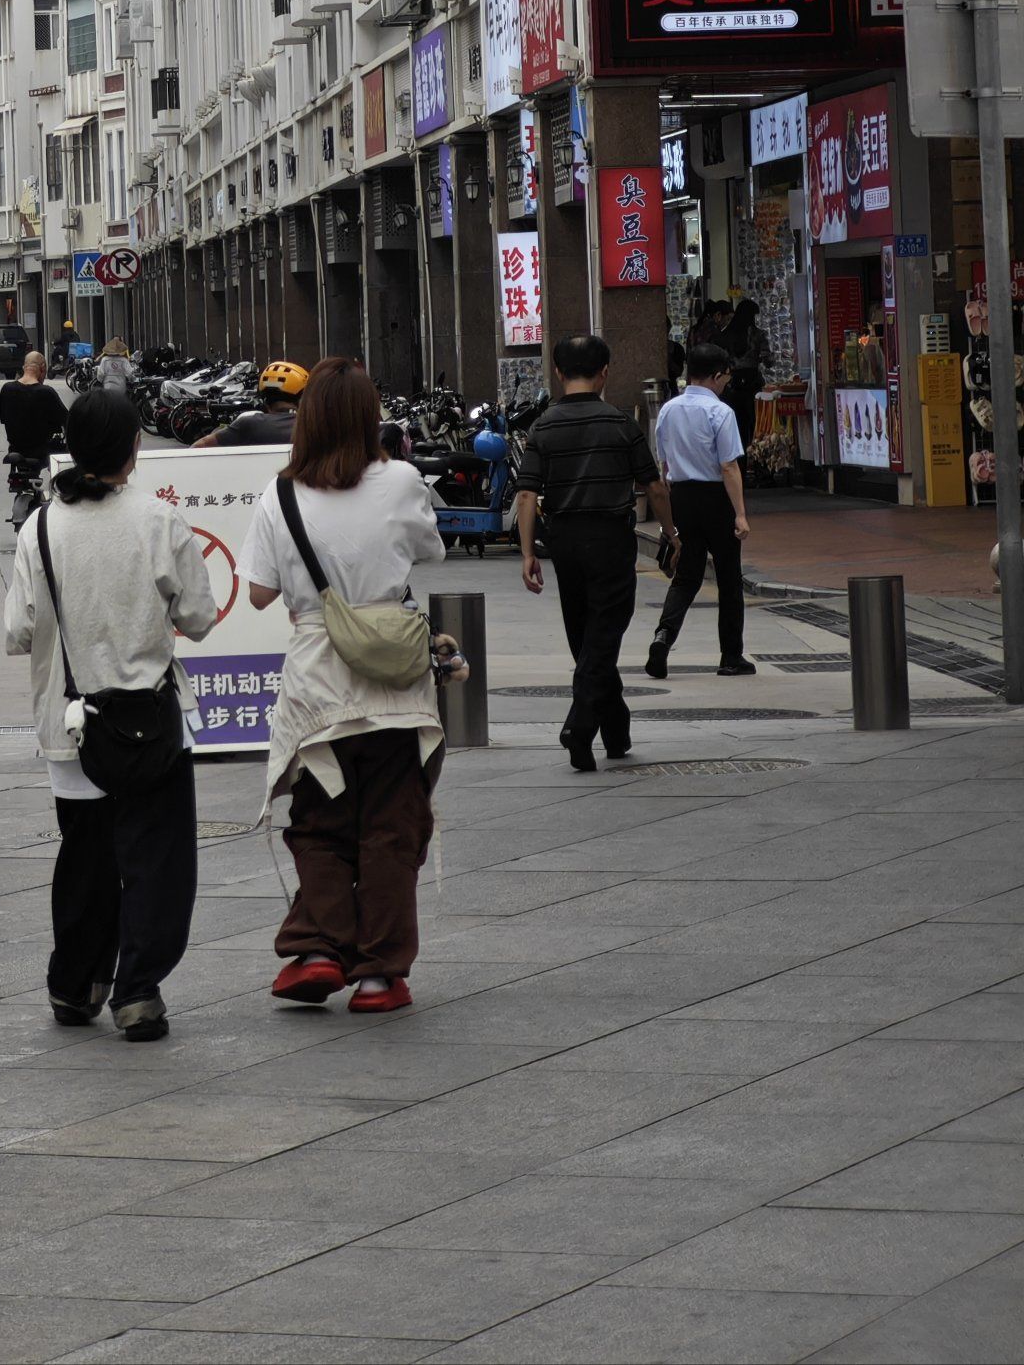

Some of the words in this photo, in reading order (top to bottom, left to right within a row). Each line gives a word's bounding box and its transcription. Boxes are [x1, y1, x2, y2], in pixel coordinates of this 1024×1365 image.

[675, 16, 726, 28] 百年传承
[733, 14, 784, 26] 风味独特
[862, 111, 889, 175] 臭豆腐
[616, 174, 649, 283] 臭豆腐
[502, 247, 528, 319] 珍珠
[185, 492, 265, 507] 商业步行
